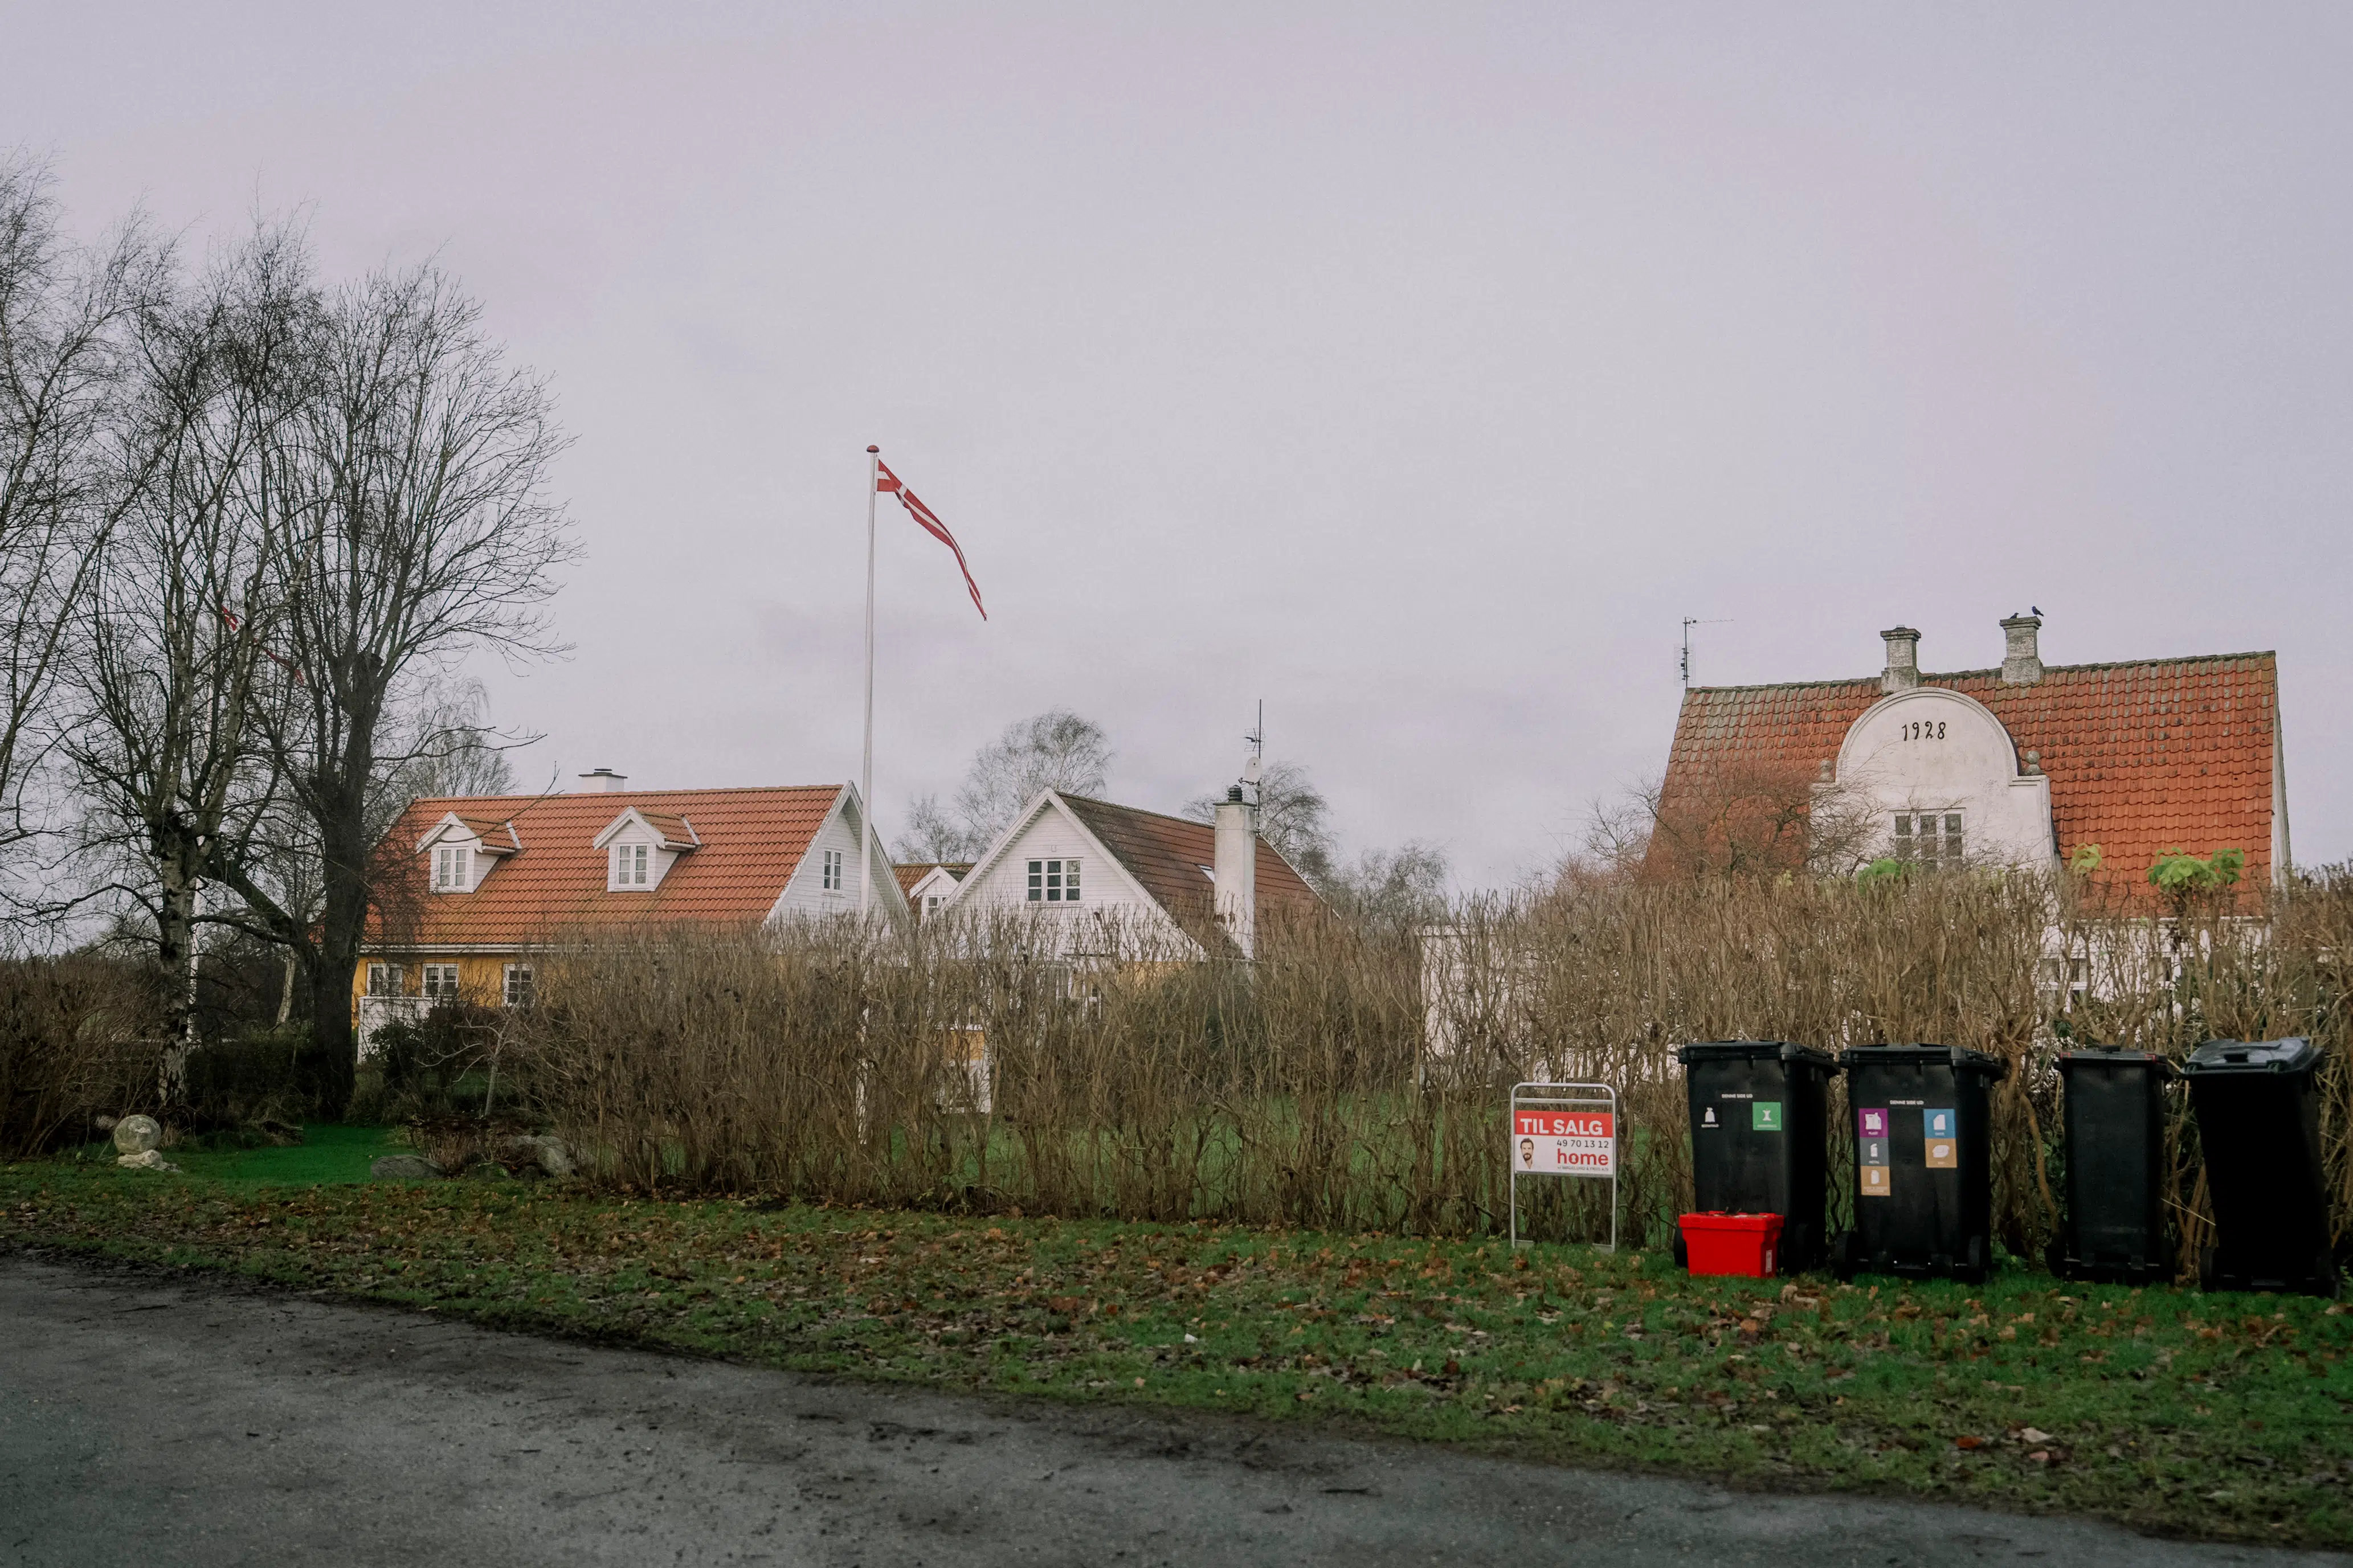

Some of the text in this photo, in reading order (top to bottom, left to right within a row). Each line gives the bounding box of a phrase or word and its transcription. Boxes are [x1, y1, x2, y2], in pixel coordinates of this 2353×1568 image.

[1901, 721, 1946, 741] 1928
[1520, 1118, 1603, 1135] TIL SALG
[1557, 1148, 1608, 1166] home
